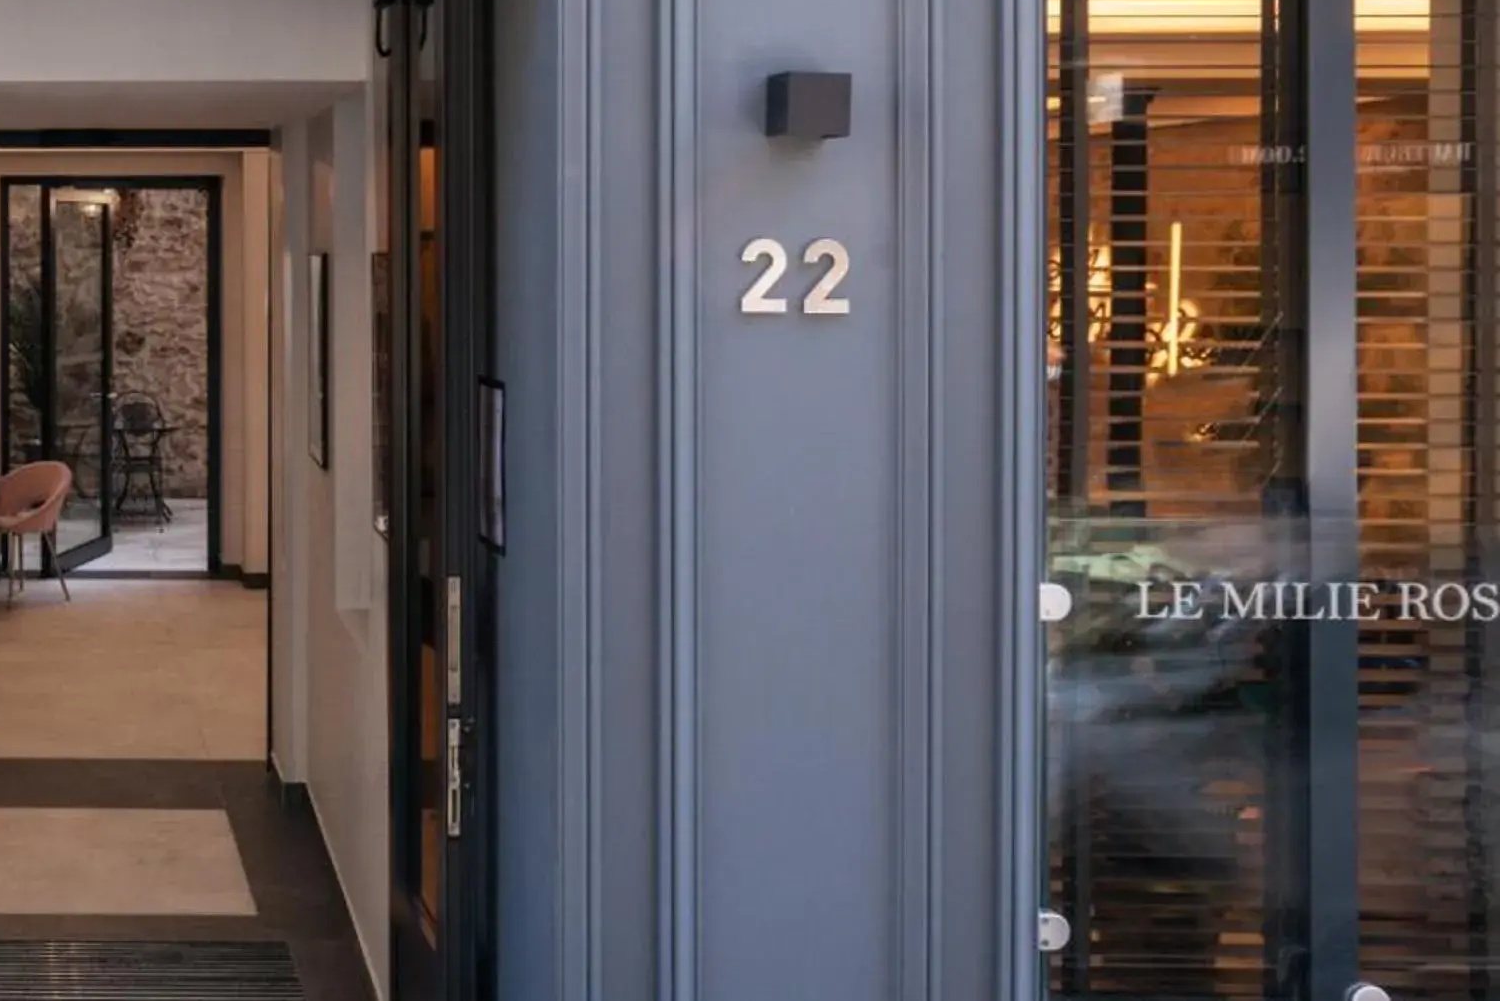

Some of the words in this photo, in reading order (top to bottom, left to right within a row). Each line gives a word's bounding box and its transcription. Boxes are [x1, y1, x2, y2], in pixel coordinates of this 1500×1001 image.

[741, 238, 850, 314] 22
[1134, 581, 1204, 620] LE
[1220, 581, 1381, 621] MILIE
[1396, 582, 1500, 622] ROS
